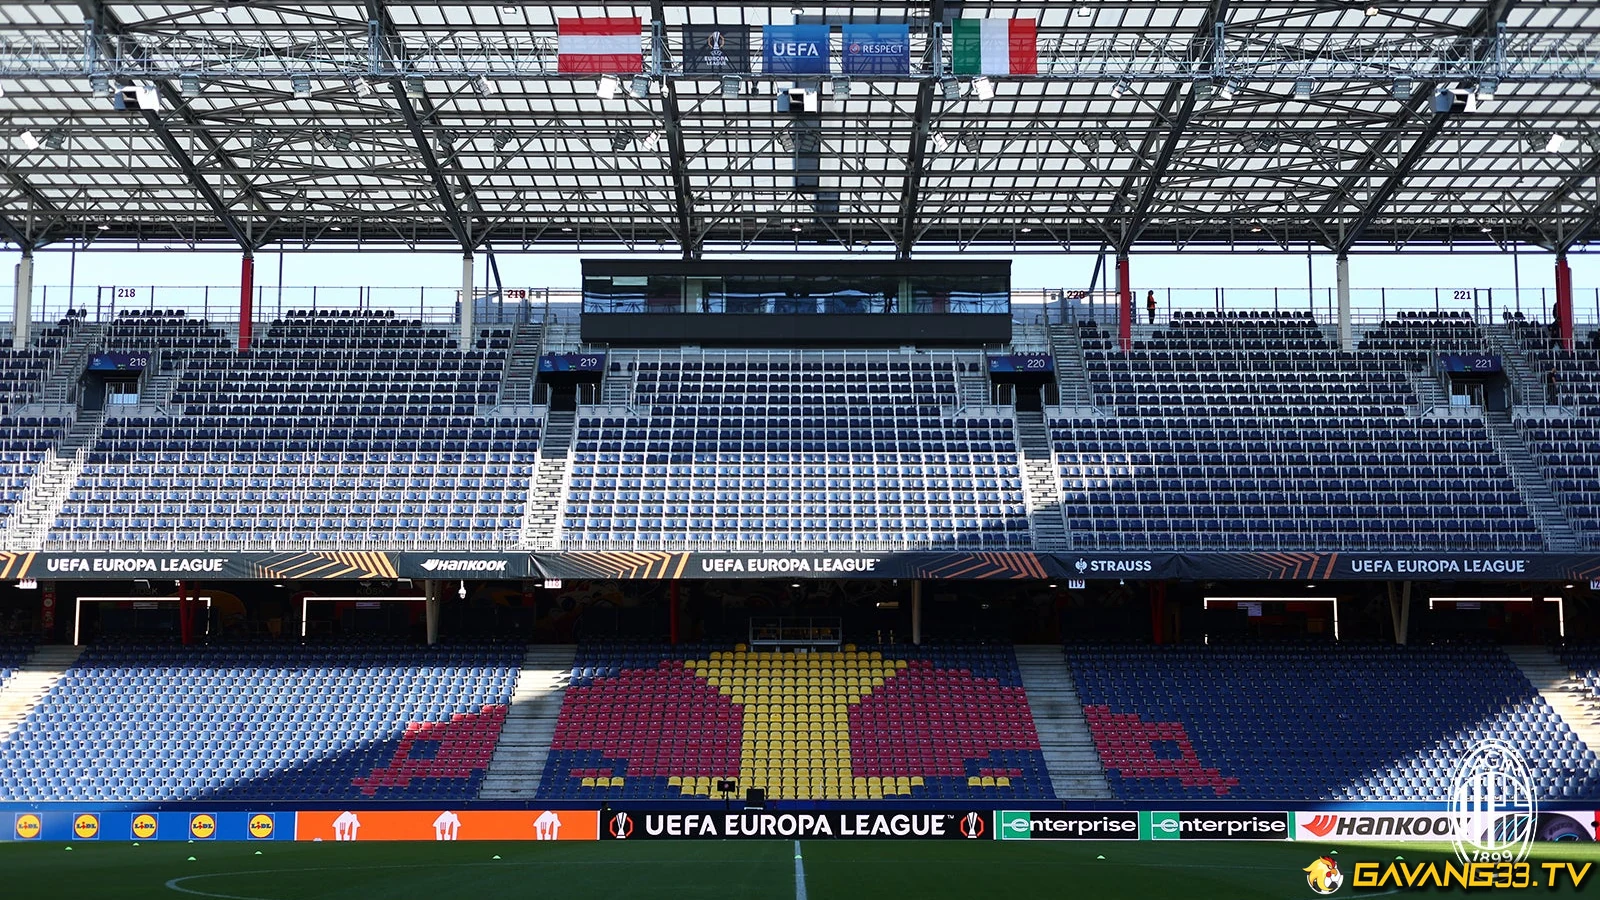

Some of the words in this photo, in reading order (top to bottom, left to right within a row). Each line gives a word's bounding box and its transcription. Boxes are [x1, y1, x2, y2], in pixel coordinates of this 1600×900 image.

[773, 43, 819, 56] UEFA
[862, 45, 904, 54] RESPECT
[117, 288, 136, 298] 218
[1453, 290, 1472, 300] 221
[129, 357, 147, 367] 218
[580, 358, 598, 367] 219
[1027, 358, 1046, 369] 220
[1475, 359, 1492, 368] 221
[47, 558, 90, 572] UEFA
[93, 558, 158, 572] EUROPA
[702, 558, 745, 572] UEFA
[747, 558, 811, 572] EUROPA
[1090, 559, 1152, 572] STRAUSS
[1351, 559, 1394, 573] UEFA
[1397, 559, 1460, 573] EUROPA
[645, 814, 717, 836] UEFA
[725, 814, 833, 836] EUROPA
[1011, 816, 1137, 836] enterprise
[1160, 816, 1286, 836] enterprise
